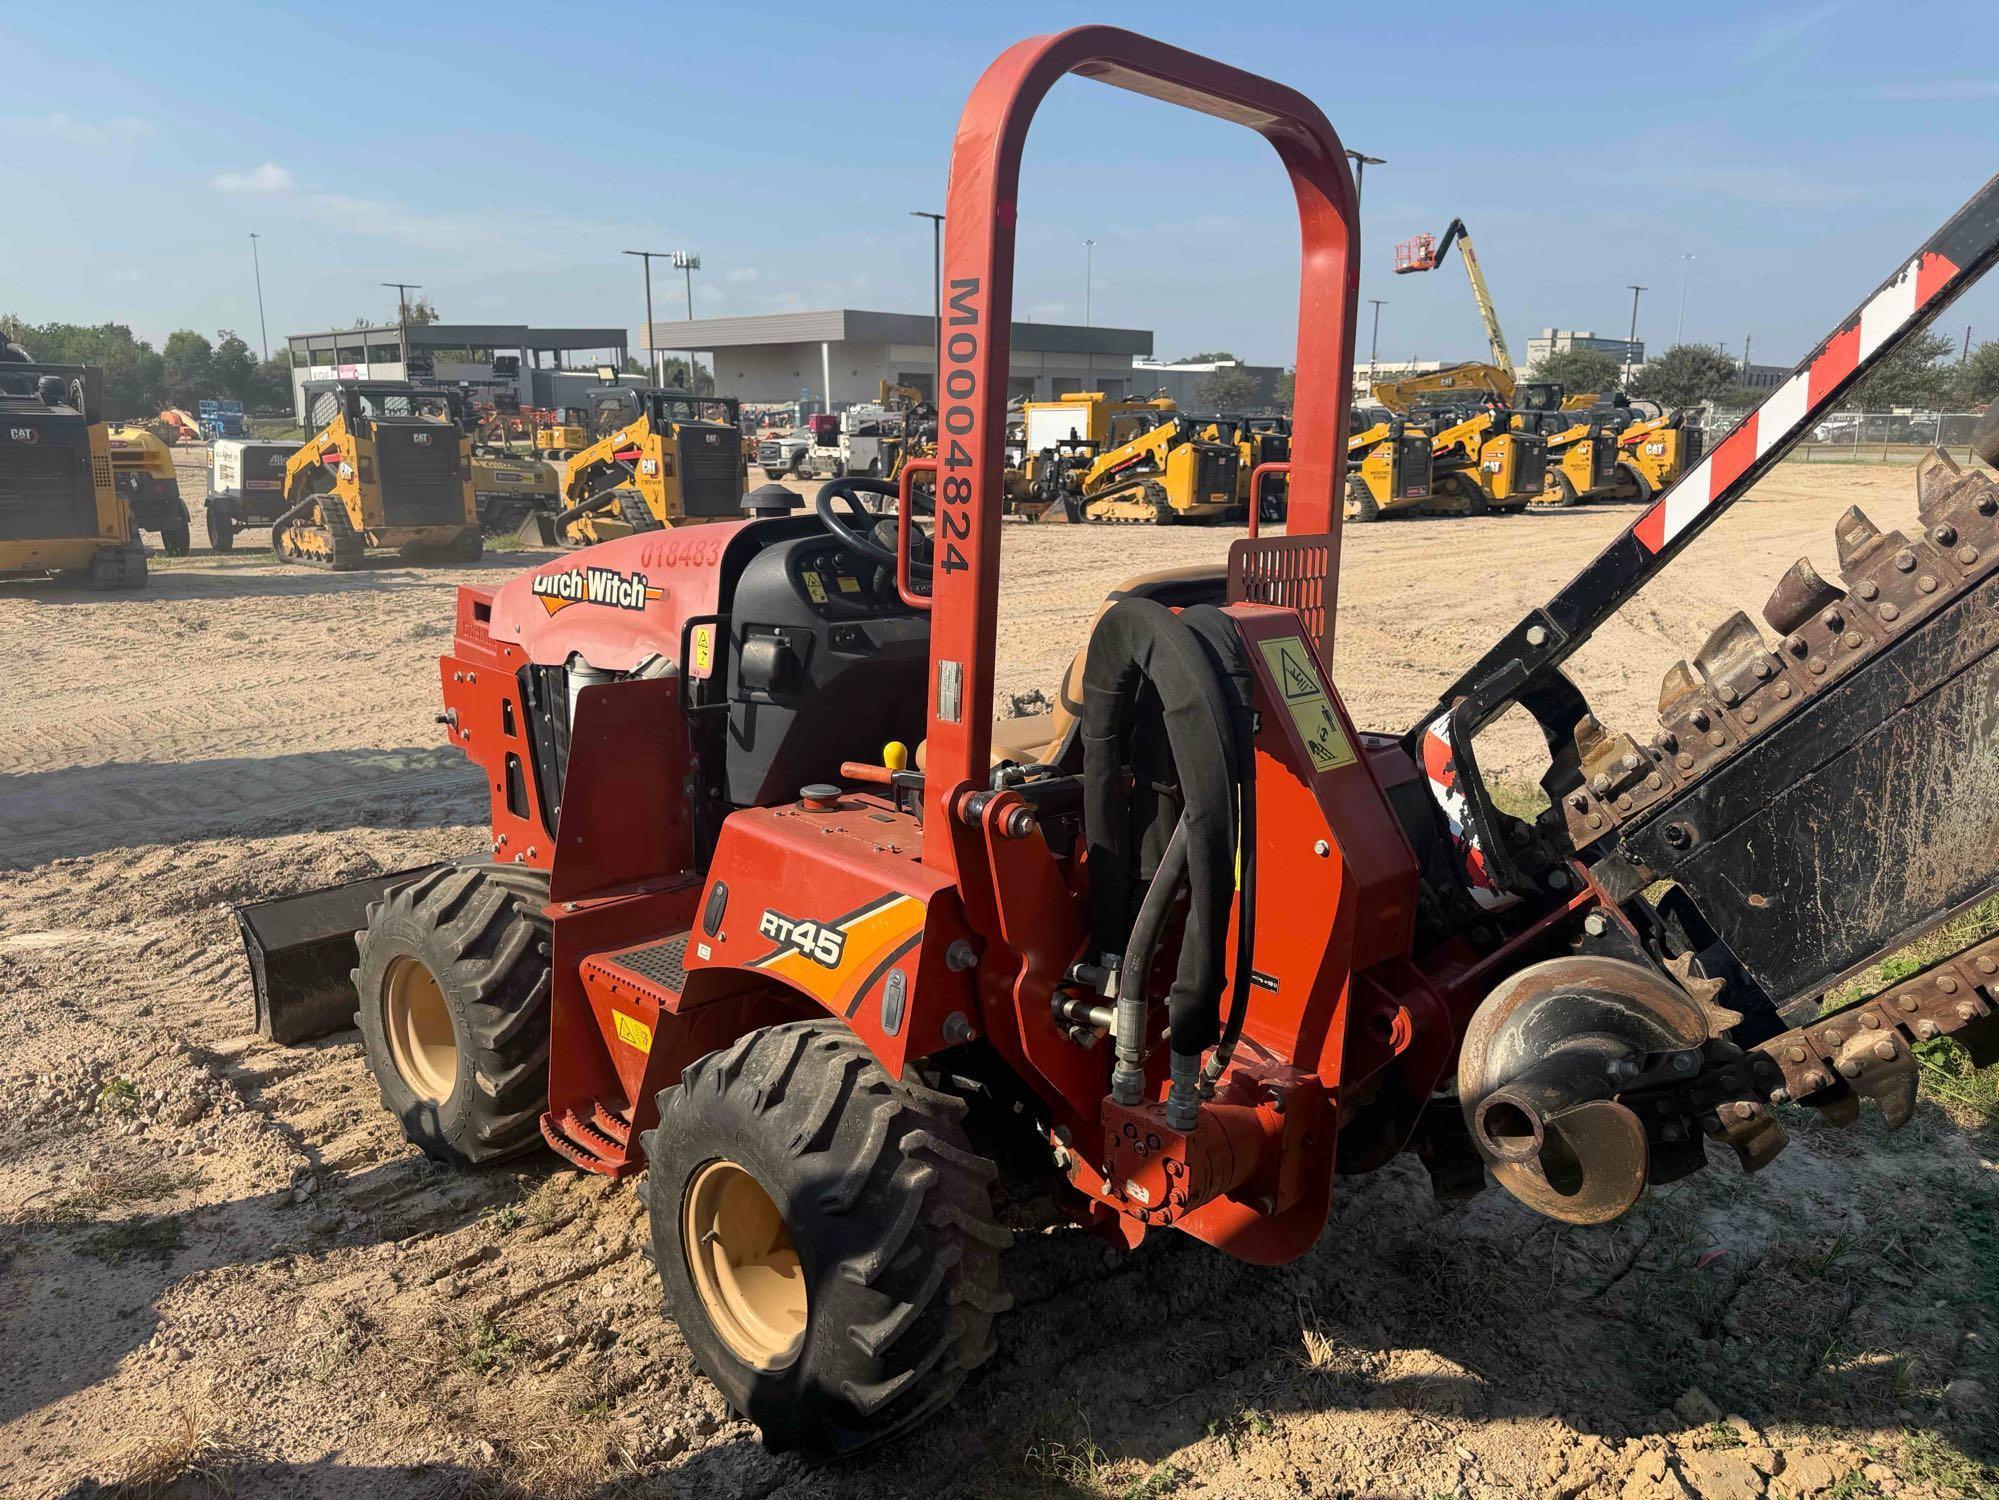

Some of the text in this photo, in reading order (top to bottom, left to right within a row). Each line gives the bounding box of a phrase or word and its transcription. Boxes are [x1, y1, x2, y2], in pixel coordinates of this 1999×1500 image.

[941, 277, 980, 575] M0004824
[11, 428, 32, 440] CAT
[413, 433, 428, 443] CAT
[705, 433, 717, 443] CAT
[1645, 443, 1664, 456] CAT
[642, 458, 656, 475] CAT
[1484, 461, 1501, 472] CAT
[640, 537, 722, 569] 018483
[587, 569, 645, 608] Witch
[760, 911, 843, 964] RT45
